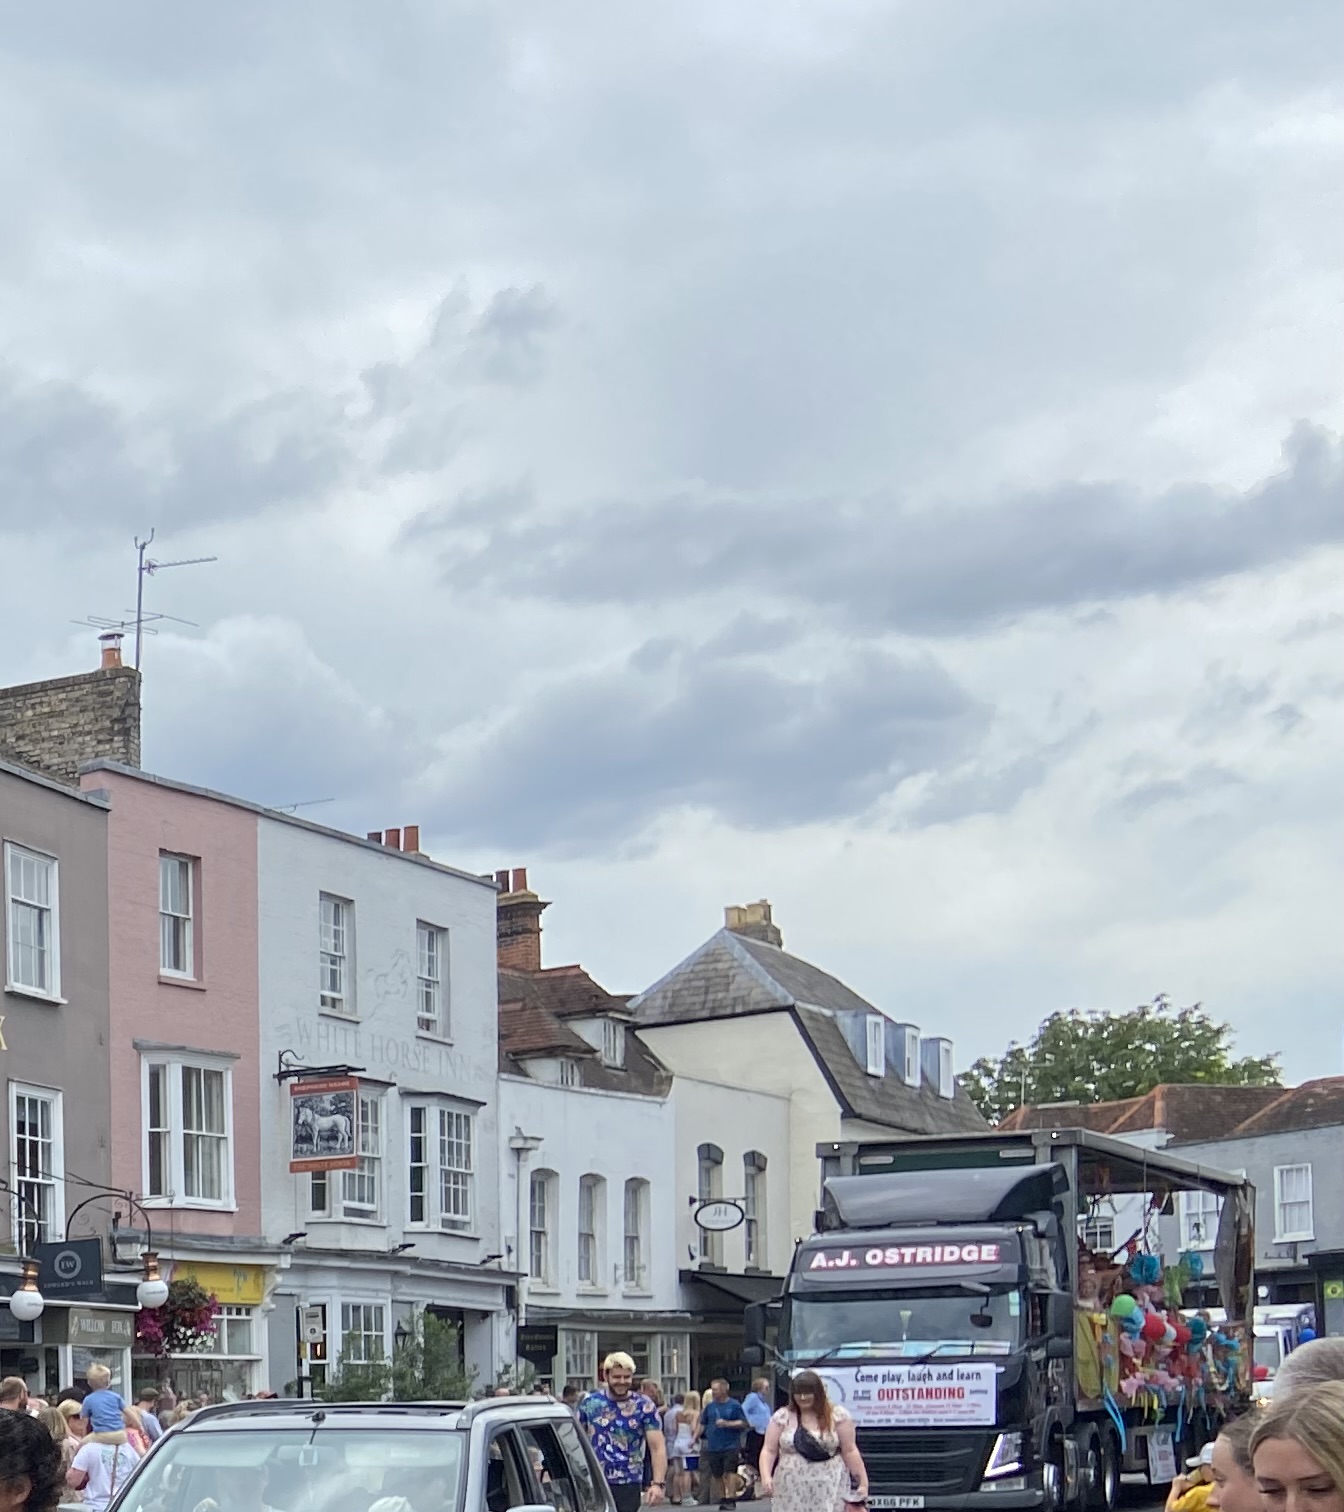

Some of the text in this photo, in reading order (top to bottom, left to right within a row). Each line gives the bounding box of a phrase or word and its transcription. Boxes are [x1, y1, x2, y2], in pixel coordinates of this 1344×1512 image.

[296, 1016, 472, 1083] WHITE HORSE INN
[810, 1243, 1001, 1270] A.J. OSTRIDGE
[854, 1364, 982, 1385] Come play, laugh and learn
[876, 1386, 965, 1401] OUTSTANDING
